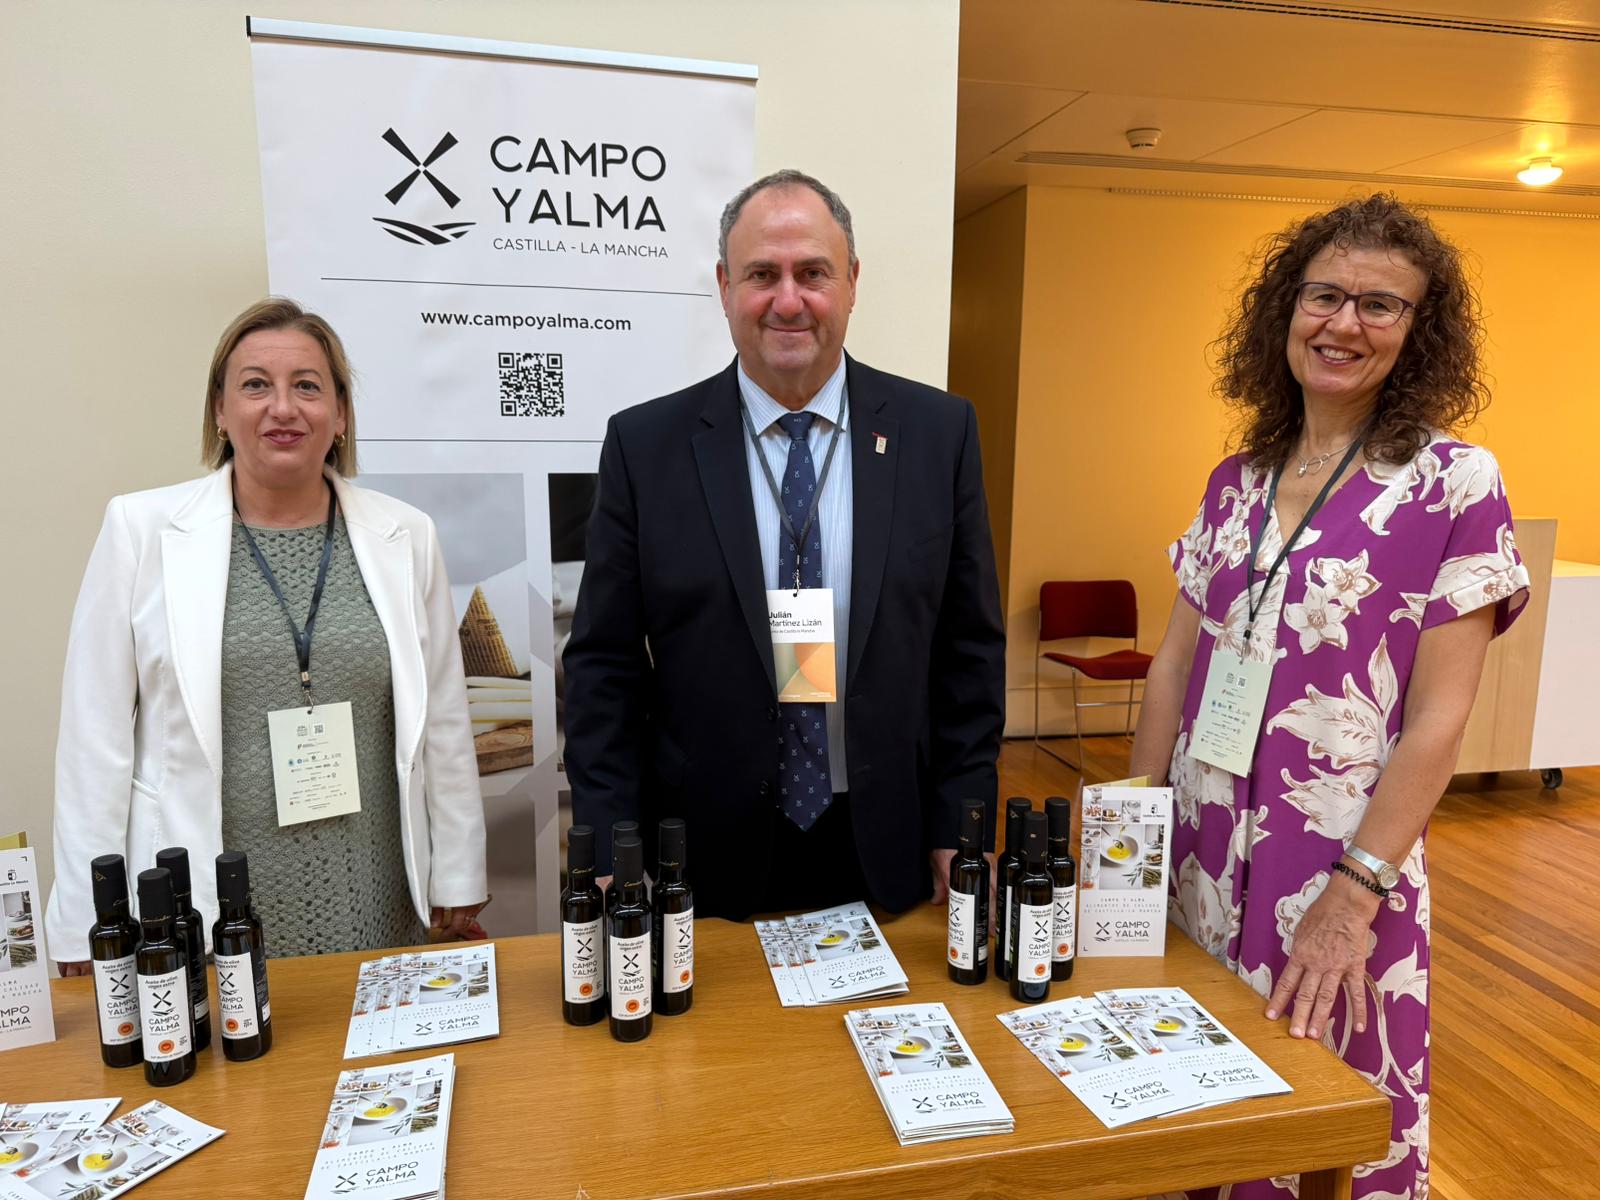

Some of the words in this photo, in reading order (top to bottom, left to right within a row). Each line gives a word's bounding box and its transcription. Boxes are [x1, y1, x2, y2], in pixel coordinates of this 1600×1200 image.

[490, 135, 667, 182] CAMPO
[491, 187, 667, 232] YALMA
[493, 238, 567, 252] CASTILLA
[581, 242, 600, 254] LA
[604, 243, 669, 258] MANCHA
[420, 310, 632, 331] www.campoyalma.com
[1115, 921, 1150, 929] CAMPO
[1115, 930, 1149, 938] YALMA
[572, 960, 598, 969] CAMPO
[848, 965, 884, 977] CAMPO
[618, 976, 645, 985] CAMPO
[0, 1005, 30, 1018] MPO
[148, 1014, 180, 1026] CAMPO
[438, 1014, 480, 1025] CAMPO
[439, 1020, 480, 1031] YALMA
[1213, 1067, 1253, 1076] CAMPO
[1219, 1073, 1260, 1083] YALMA
[1124, 1080, 1163, 1095] CAMPO
[936, 1091, 979, 1101] CAMPO
[1131, 1087, 1170, 1101] YALMA
[940, 1098, 984, 1108] YALMA
[366, 1161, 419, 1177] CAMPO
[366, 1170, 417, 1185] YALMA
